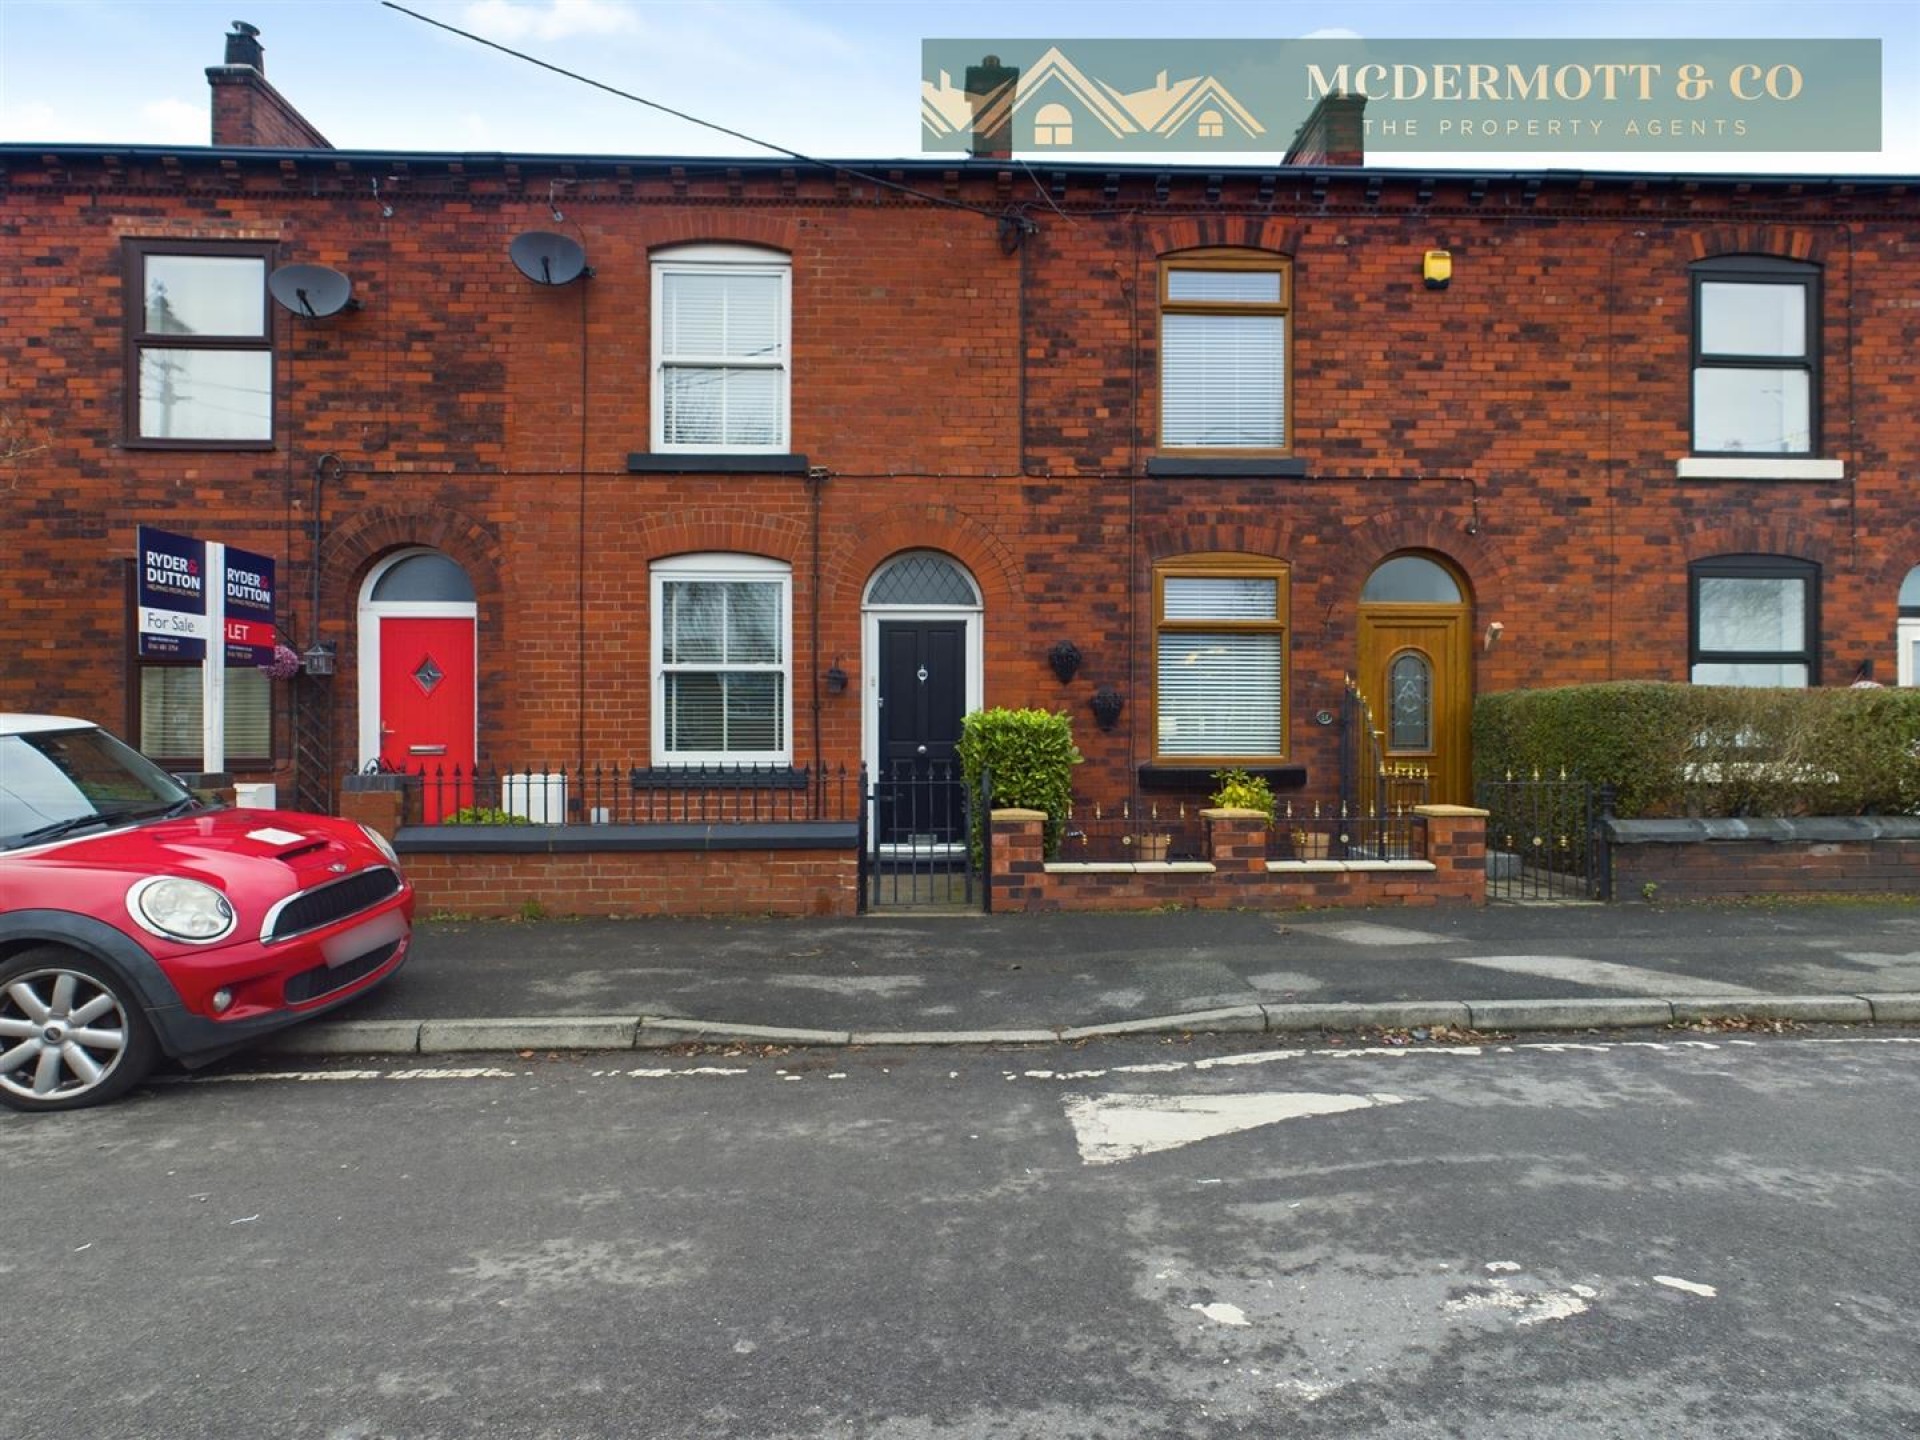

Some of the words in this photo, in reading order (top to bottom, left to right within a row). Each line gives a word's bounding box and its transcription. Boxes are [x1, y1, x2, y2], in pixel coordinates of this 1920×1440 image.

[147, 567, 201, 590] DUTTON
[227, 583, 271, 604] DUTTON
[147, 612, 169, 628] For
[171, 615, 195, 633] Sale
[227, 623, 249, 641] LET
